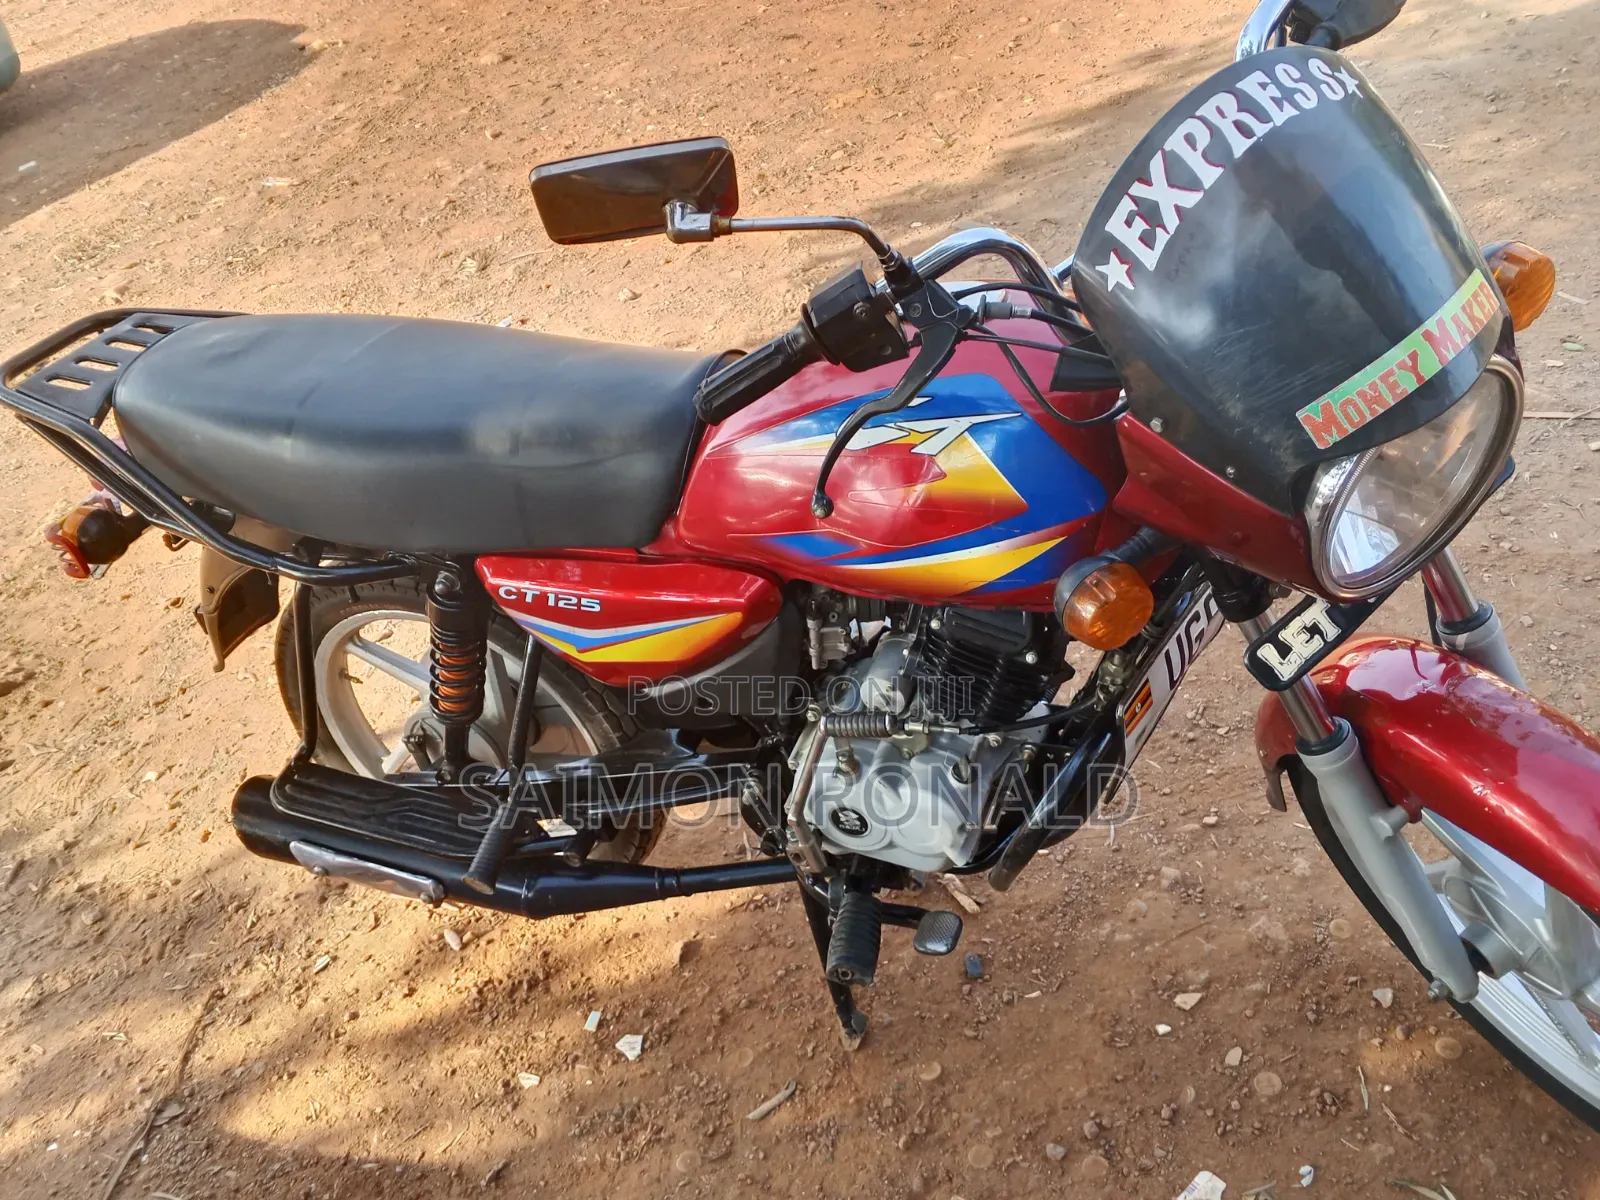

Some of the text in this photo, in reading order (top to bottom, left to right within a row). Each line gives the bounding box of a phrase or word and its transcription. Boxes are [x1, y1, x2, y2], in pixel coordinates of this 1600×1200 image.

[1105, 58, 1346, 271] EXPRESS
[1300, 281, 1499, 450] MONEY MAKER
[1256, 597, 1342, 681] LET
